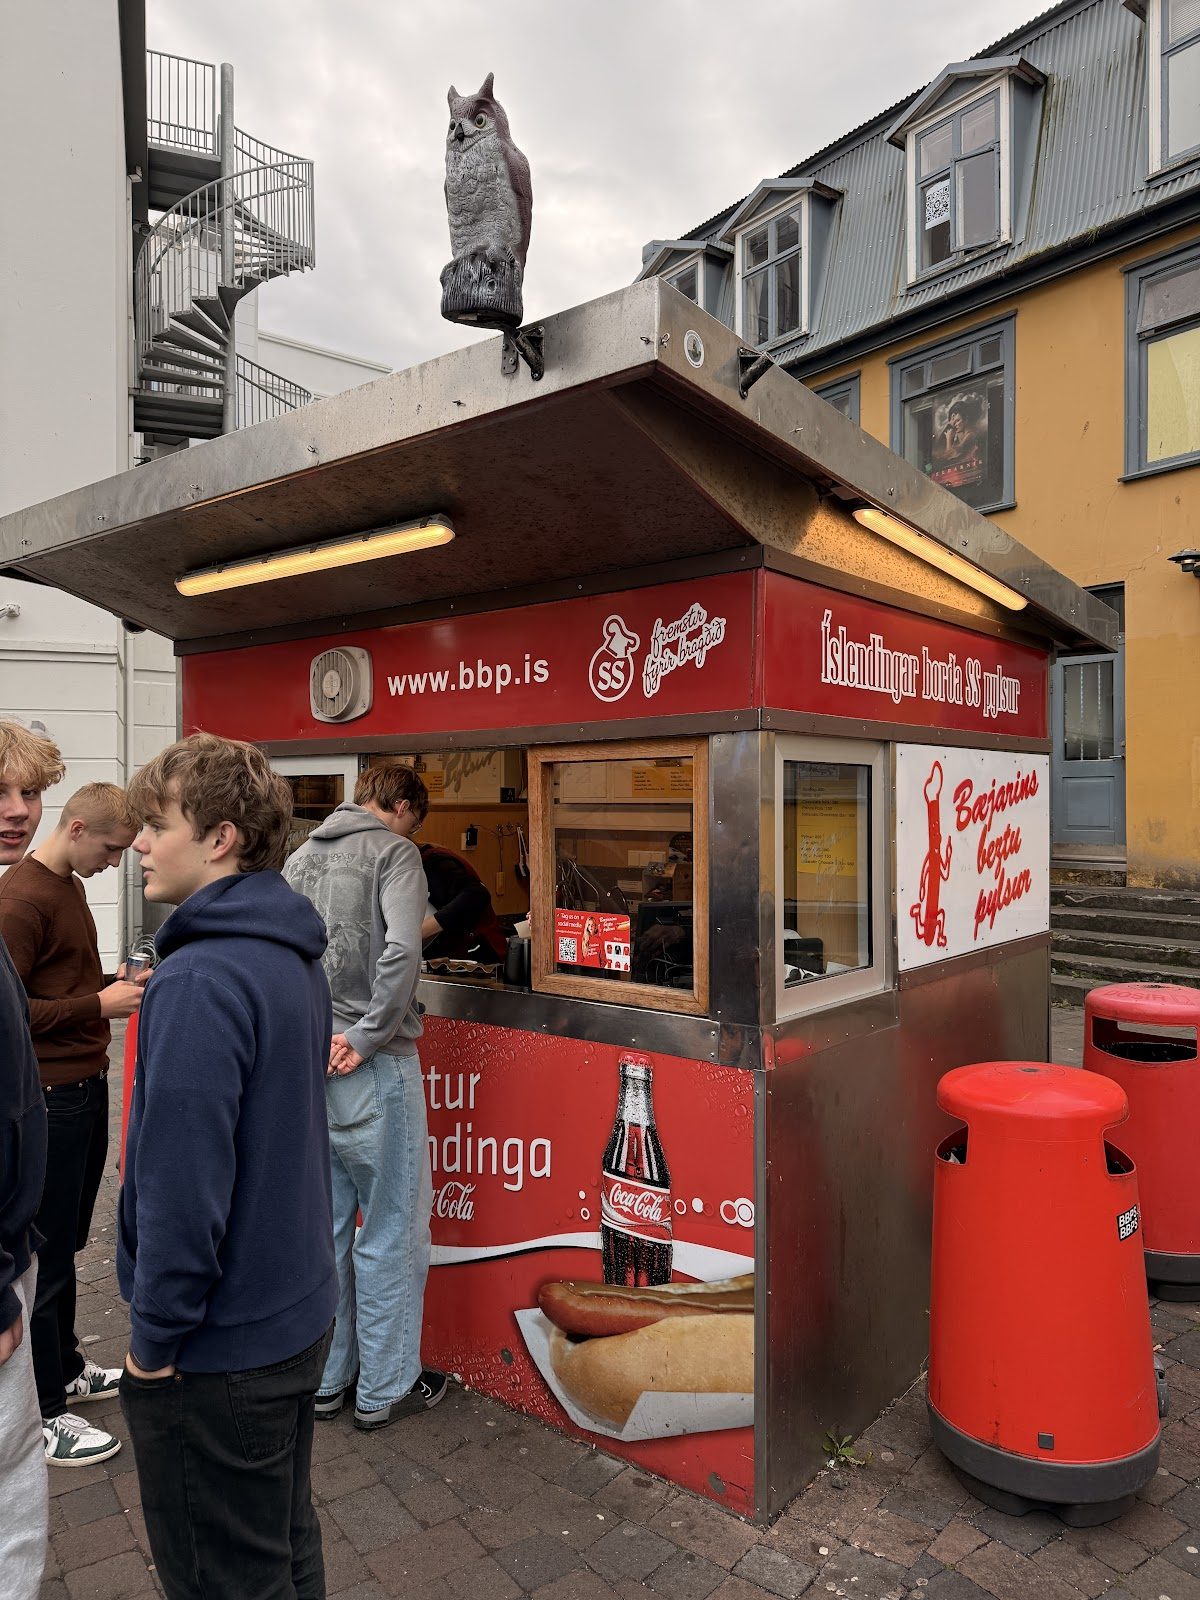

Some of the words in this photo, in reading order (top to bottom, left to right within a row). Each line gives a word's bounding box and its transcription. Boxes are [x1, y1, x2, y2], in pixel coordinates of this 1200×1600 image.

[387, 653, 550, 696] www.bbp.is
[597, 660, 625, 691] SS
[642, 648, 678, 698] fyrir
[821, 609, 919, 704] Íslendingar
[922, 646, 963, 705] borða
[965, 657, 981, 707] SS
[983, 665, 1020, 718] pylsur
[953, 769, 1039, 832] Bæjarins
[977, 823, 1022, 880] beztu
[974, 867, 1032, 941] pylsur
[609, 1182, 662, 1222] Coca-Cola
